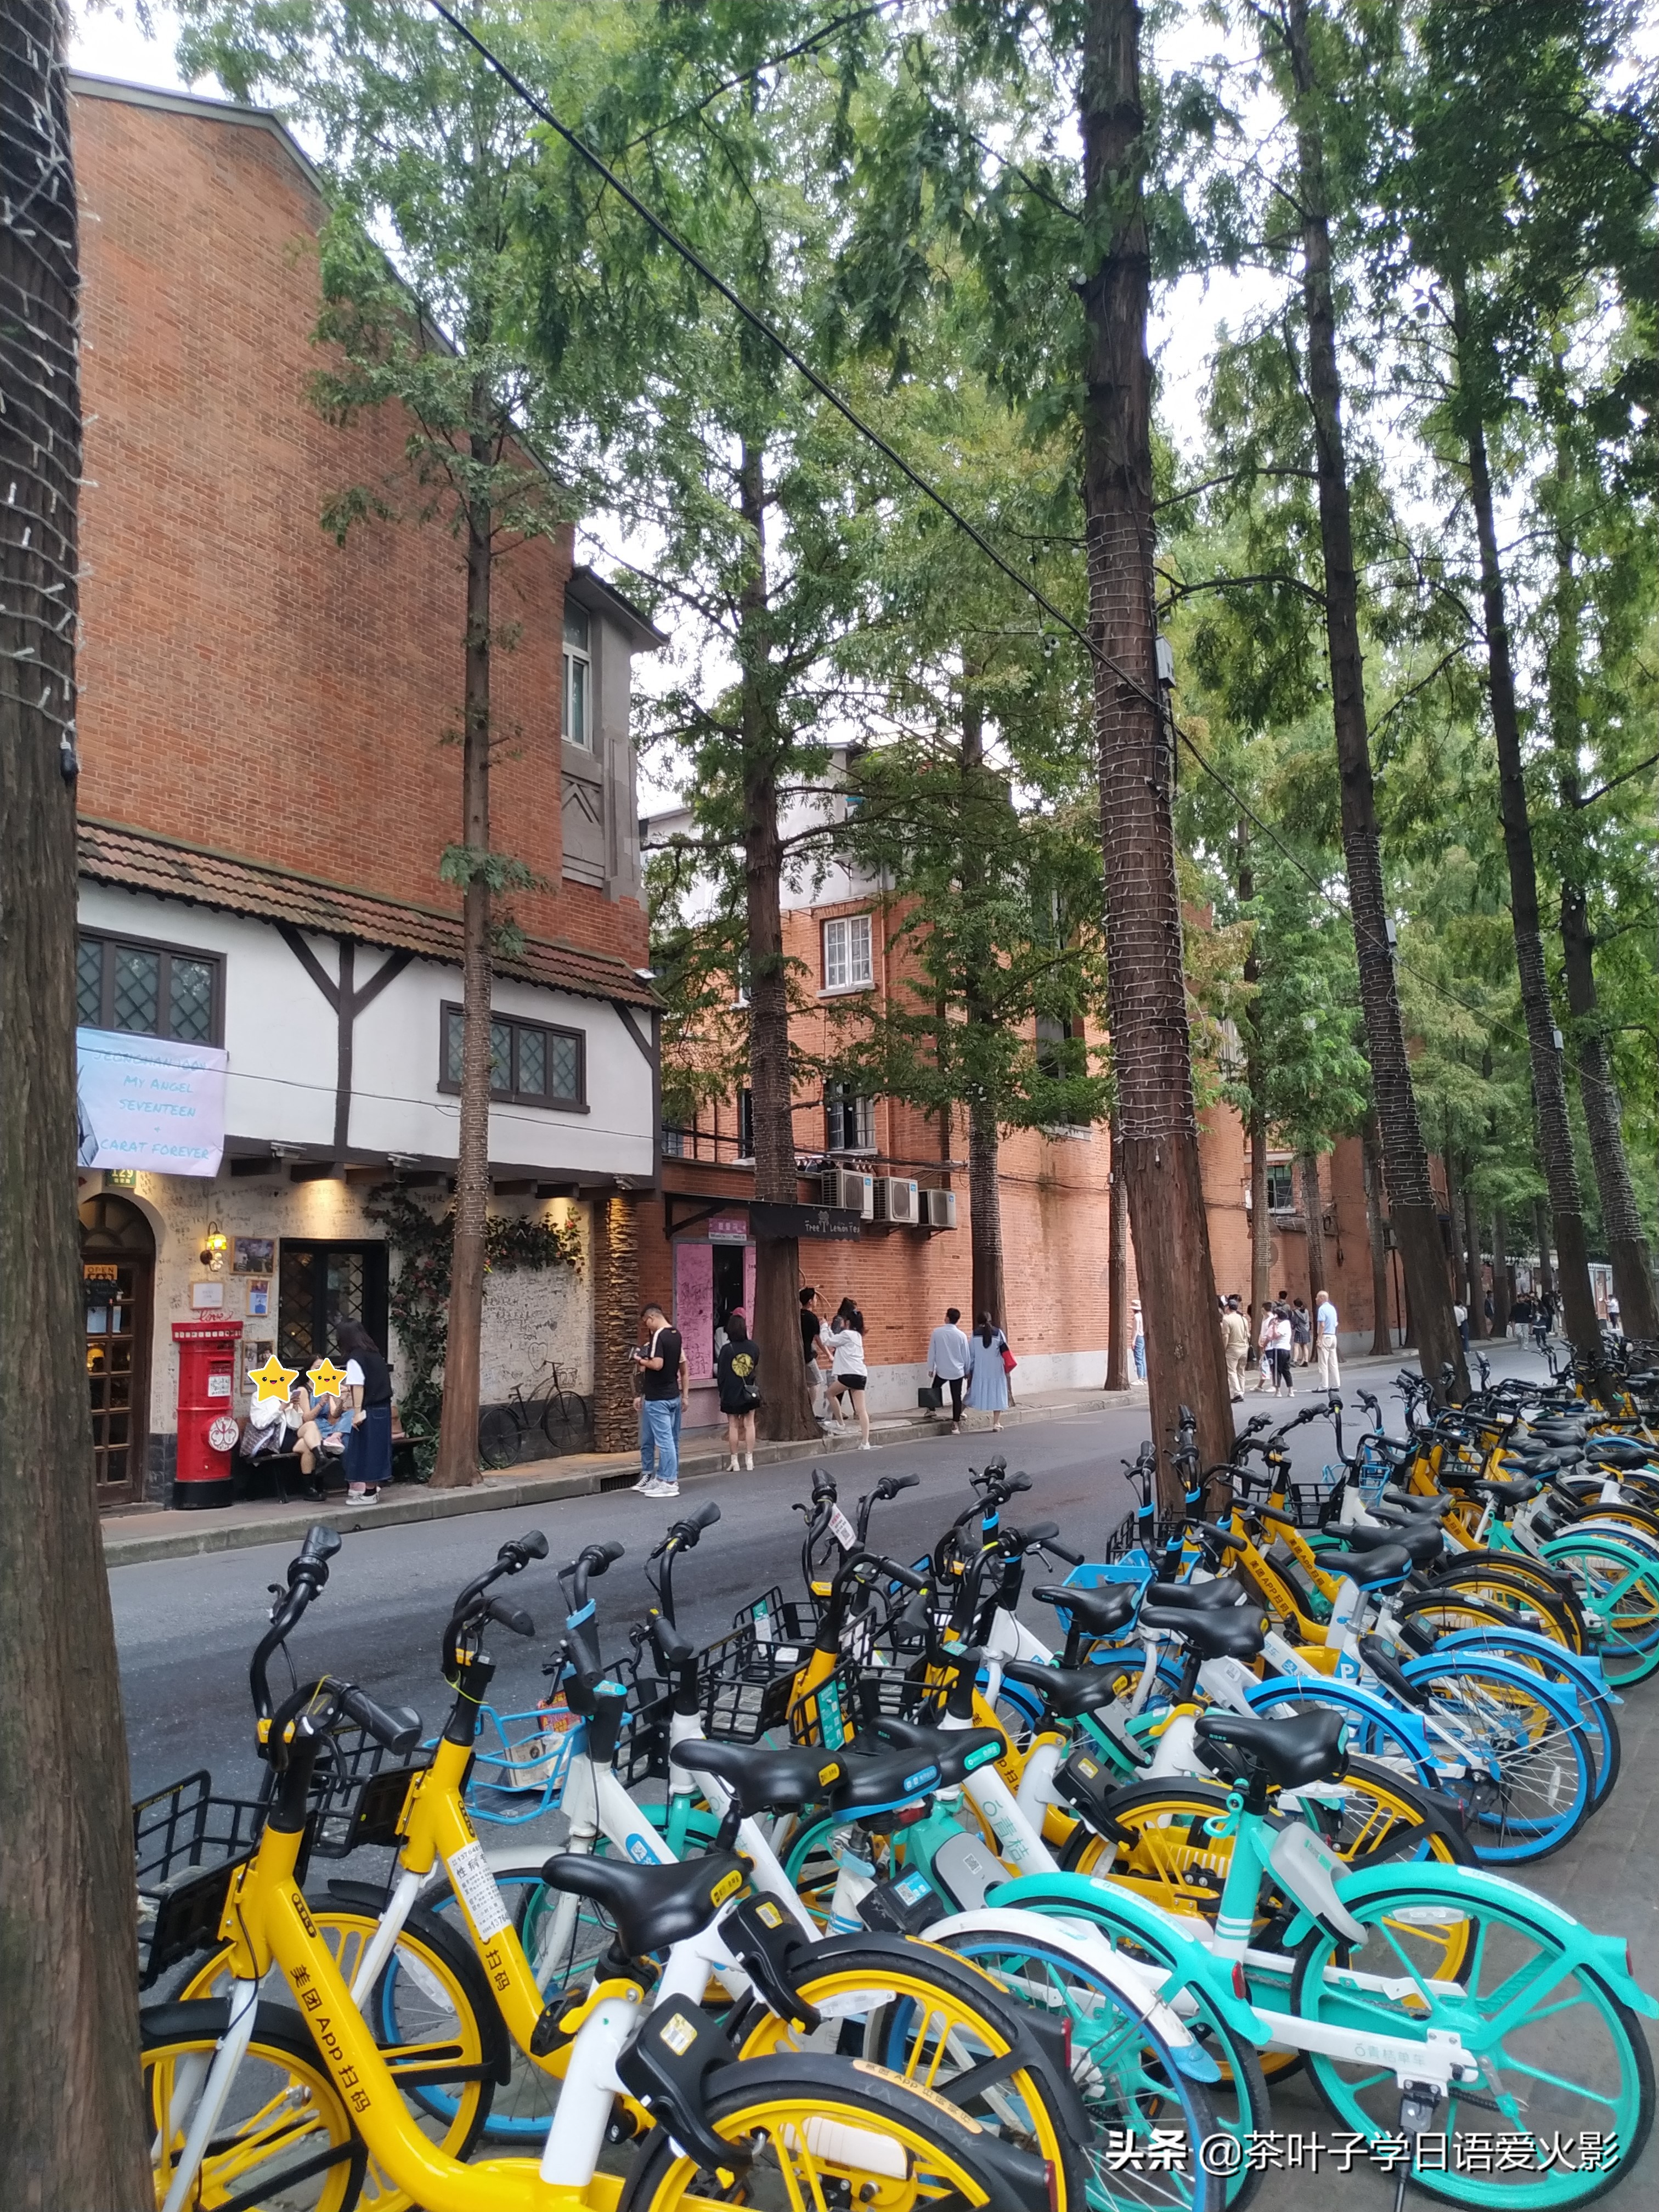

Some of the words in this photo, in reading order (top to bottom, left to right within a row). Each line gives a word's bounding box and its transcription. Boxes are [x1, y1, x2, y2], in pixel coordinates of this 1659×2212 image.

[124, 1075, 145, 1088] MY
[150, 1079, 193, 1093] ANGEL
[119, 1099, 196, 1117] SEVENTEEN
[100, 1139, 148, 1153] CARAT
[151, 1144, 209, 1159] FOREVER
[112, 1169, 133, 1178] 129
[993, 1815, 1029, 1861] 青桔
